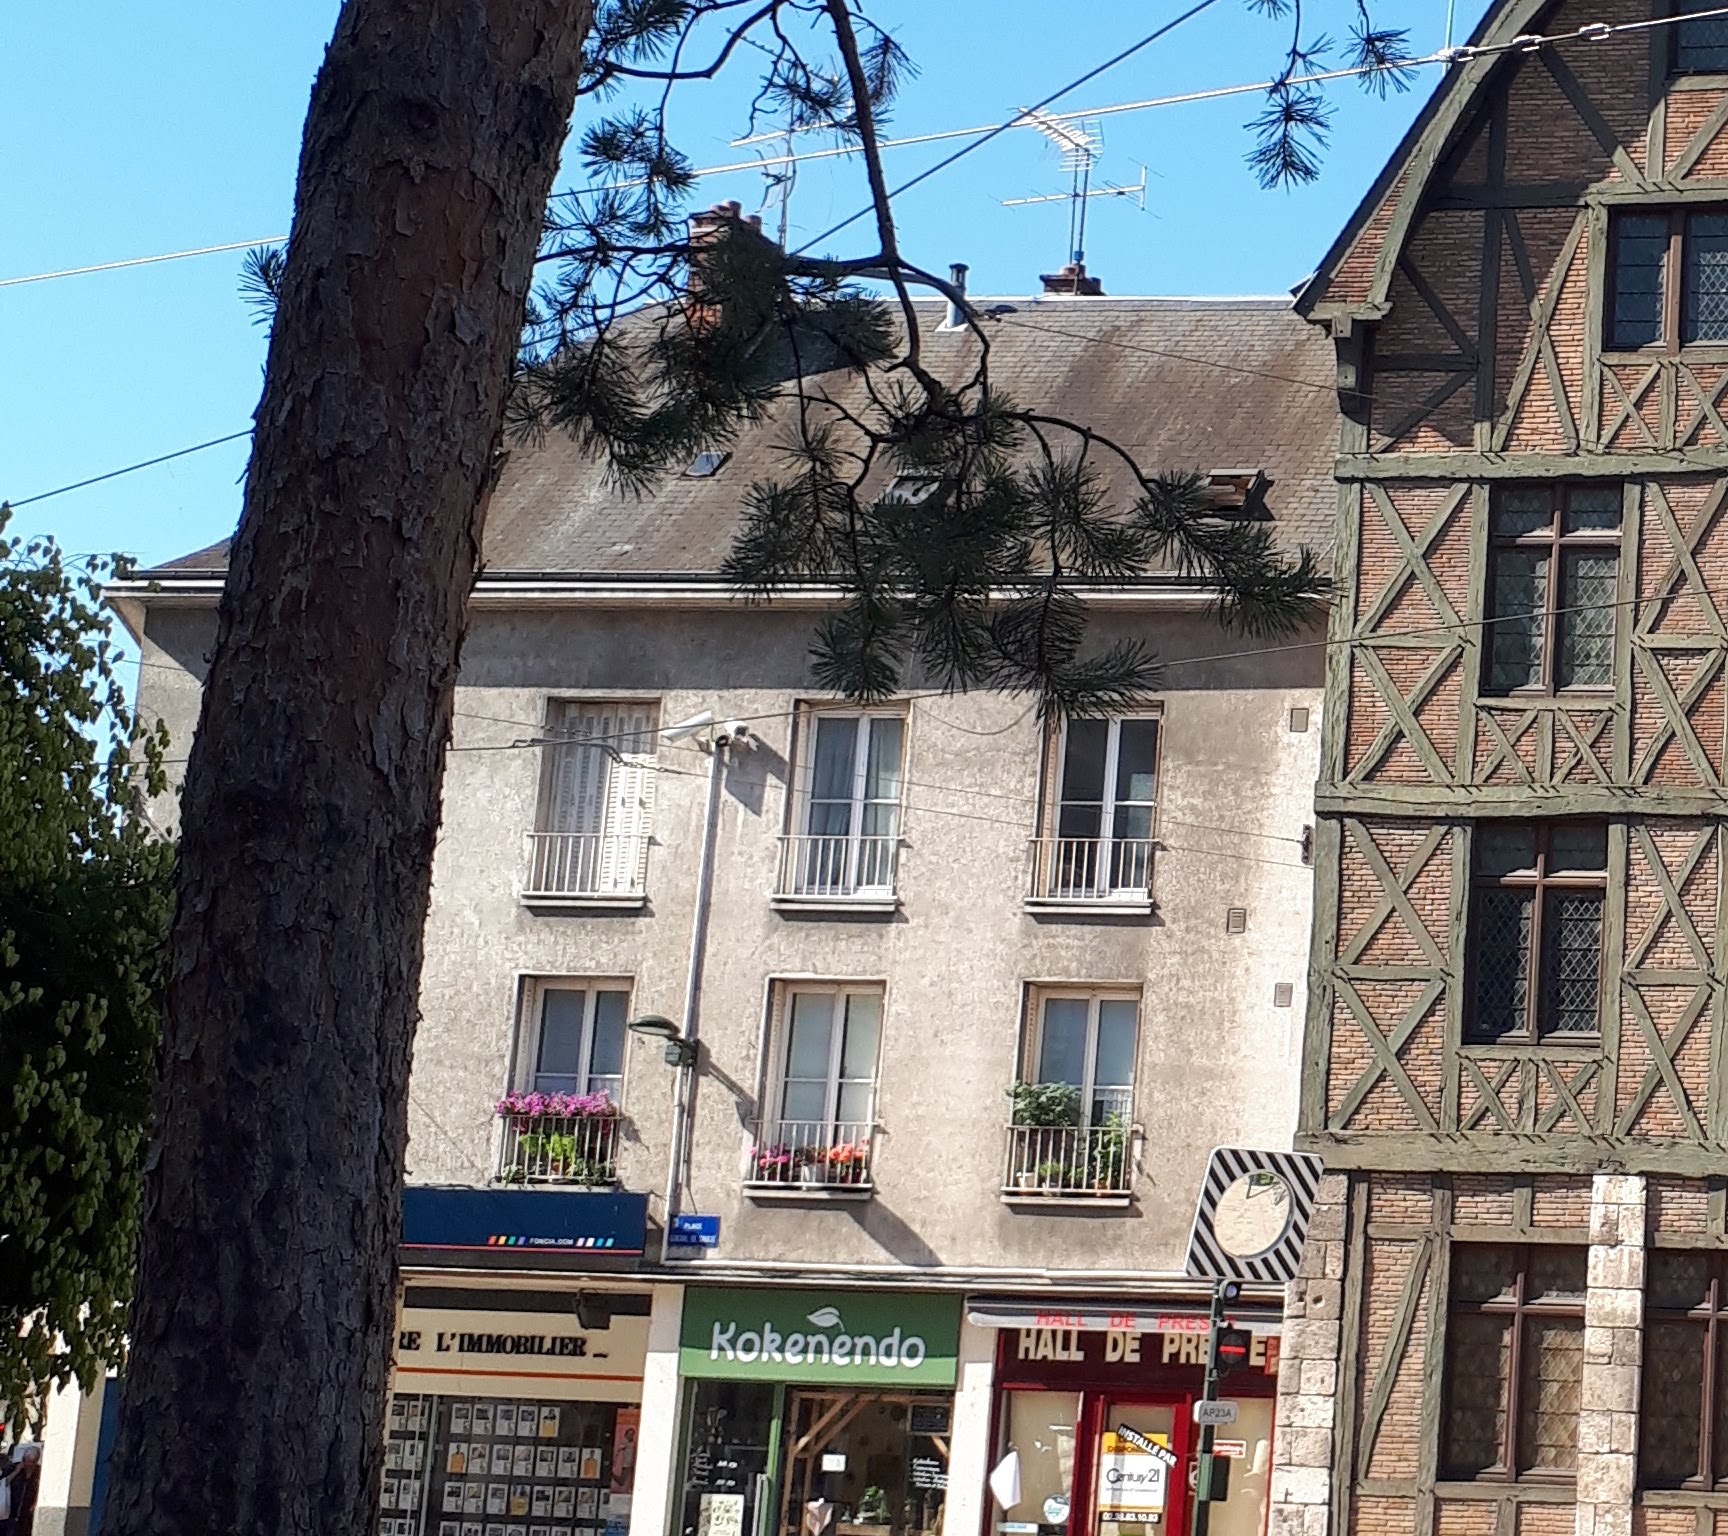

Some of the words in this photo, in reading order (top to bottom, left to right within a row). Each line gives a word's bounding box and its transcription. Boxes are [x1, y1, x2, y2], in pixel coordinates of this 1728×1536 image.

[1035, 1311, 1088, 1328] HALL
[1109, 1312, 1137, 1330] DE
[1157, 1314, 1237, 1332] PRES
[436, 1332, 587, 1357] L'IMMOBILIER
[710, 1321, 926, 1368] Kokenendo
[1018, 1328, 1085, 1362] HALL
[1105, 1331, 1142, 1364] DE
[1162, 1334, 1267, 1366] PREE
[1202, 1407, 1232, 1418] AP23A
[1157, 1448, 1178, 1467] PAR
[1148, 1468, 1161, 1483] 21
